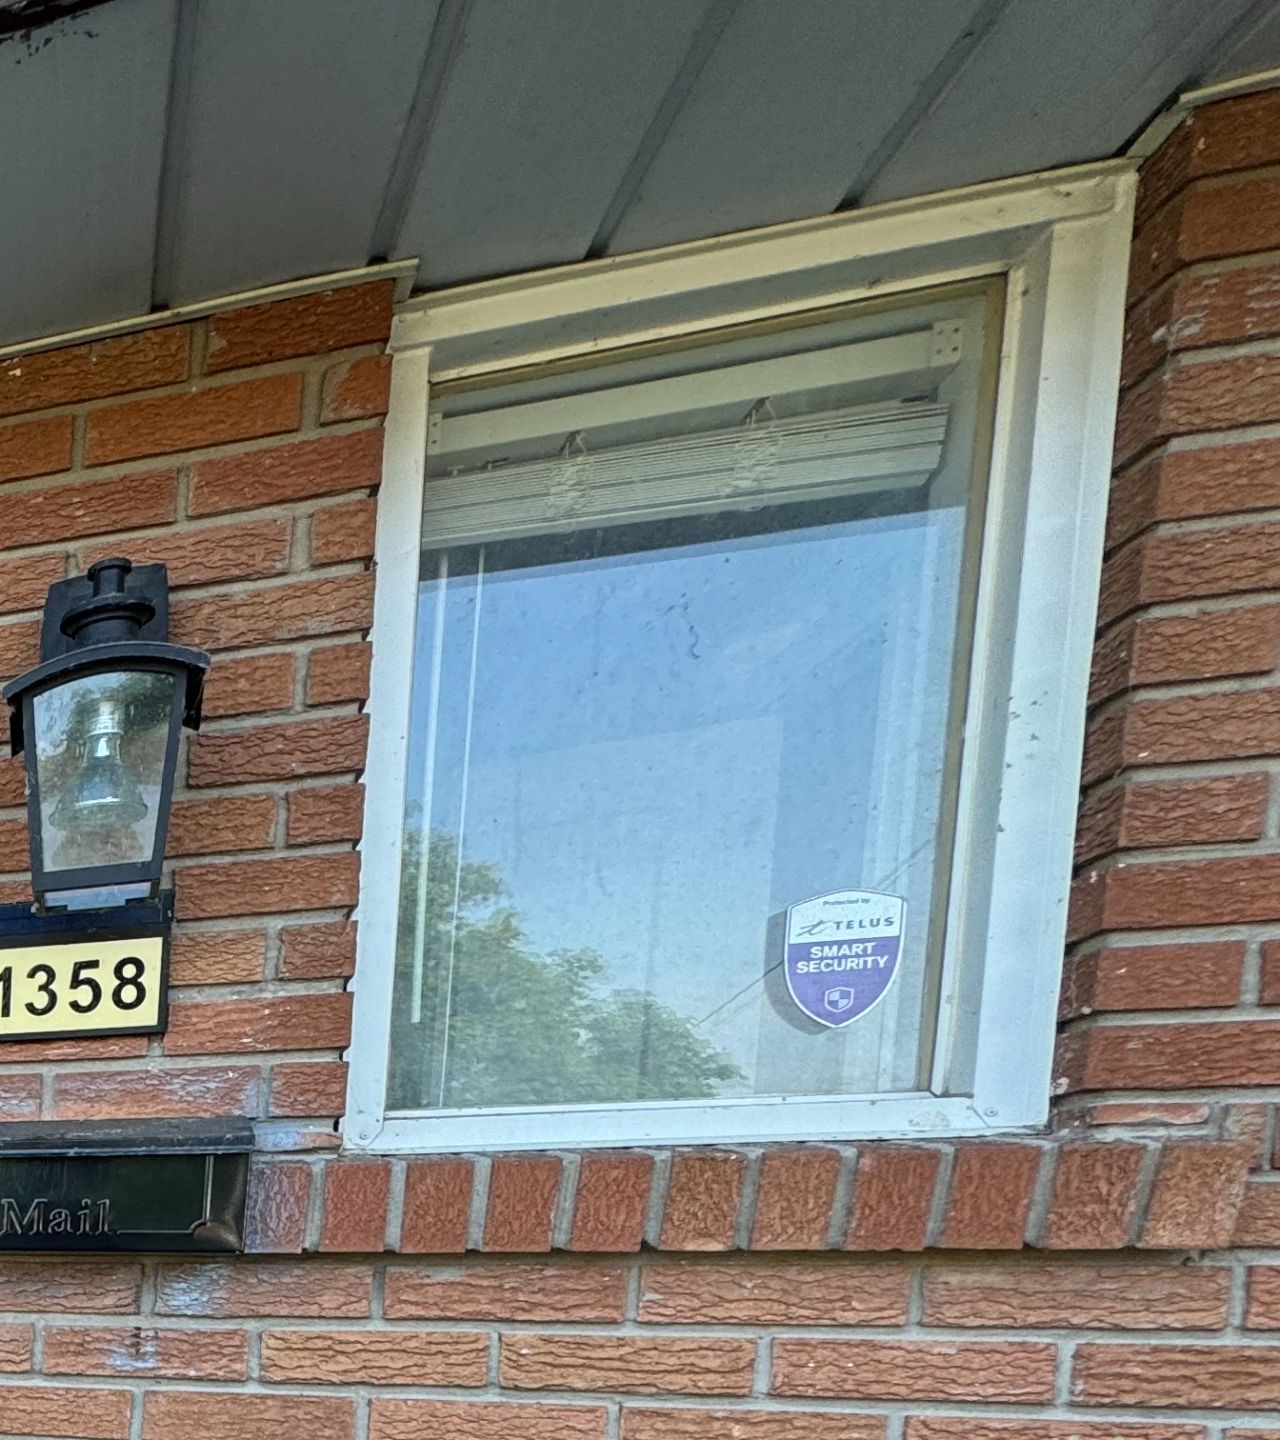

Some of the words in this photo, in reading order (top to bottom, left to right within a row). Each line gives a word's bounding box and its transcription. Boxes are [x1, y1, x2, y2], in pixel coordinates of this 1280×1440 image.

[834, 917, 894, 930] TELUS
[810, 942, 876, 958] SMART
[796, 955, 889, 974] SECURITY
